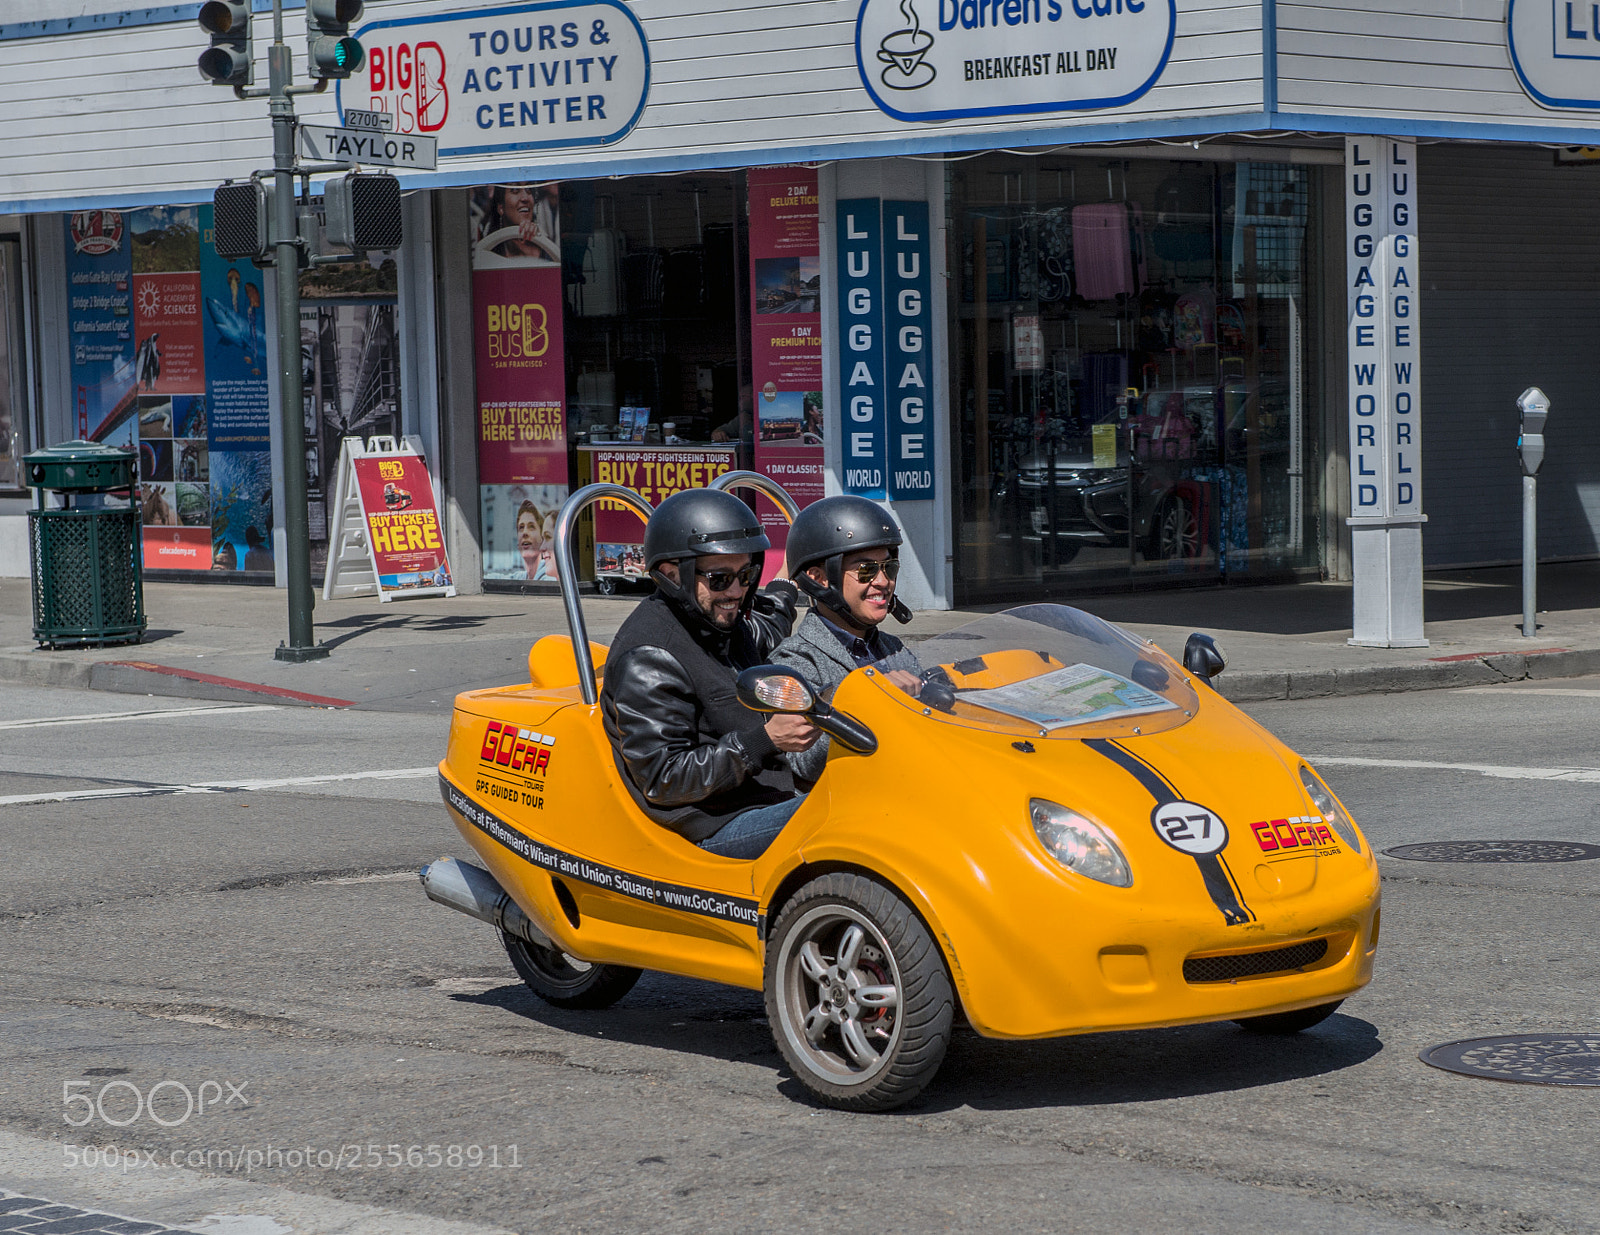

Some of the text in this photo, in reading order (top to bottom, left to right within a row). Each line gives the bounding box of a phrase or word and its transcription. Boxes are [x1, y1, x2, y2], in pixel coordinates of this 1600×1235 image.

[938, 0, 1063, 31] Darrens
[469, 18, 611, 57] TOURS &
[369, 42, 412, 92] BIG
[462, 54, 618, 94] ACTIVITY
[963, 47, 1118, 82] BREAKFAST ALL DAY
[348, 111, 379, 128] 2700
[475, 94, 607, 130] CENTER
[325, 133, 416, 162] TAYLOR
[770, 196, 799, 207] DELUXE
[787, 186, 808, 196] 2 DAY
[164, 304, 197, 314] SCIENCES
[488, 304, 520, 332] BIG
[791, 327, 812, 336] 1 DAY
[1353, 144, 1378, 506] LUGGAGE WORLD
[1392, 143, 1413, 505] LUGGAGE WORLD
[488, 333, 522, 358] BUS
[771, 337, 805, 347] PREMIUM
[846, 214, 874, 458] LUGGAGE
[896, 215, 925, 459] LUGGAGE
[509, 360, 543, 368] FRANCISCO
[481, 408, 562, 424] BUY TICKETS
[482, 424, 563, 441] HERE TODAY!
[378, 461, 392, 470] BIG
[598, 452, 730, 463] HOP-ON HOP-OFF SIGHTSEEING TOURS
[598, 462, 638, 487] BUY
[766, 465, 770, 474] 1
[772, 464, 786, 474] DAY
[786, 464, 817, 474] CLASSIC
[846, 469, 881, 488] WORLD
[895, 470, 931, 489] WORLD
[369, 513, 435, 528] BUY TICKETS
[372, 524, 441, 553] HERE
[159, 546, 196, 557] calacademy.org
[476, 780, 544, 810] GPS GUIDED TOUR
[523, 780, 544, 792] TOURS
[1160, 814, 1212, 842] 27
[450, 788, 477, 821] Locations
[476, 812, 485, 827] at
[486, 816, 530, 856] Fisherman's
[530, 844, 558, 868] Wharf
[560, 859, 579, 876] and
[581, 864, 612, 886] Union
[614, 875, 654, 899] Square
[1319, 848, 1342, 857] TOURS
